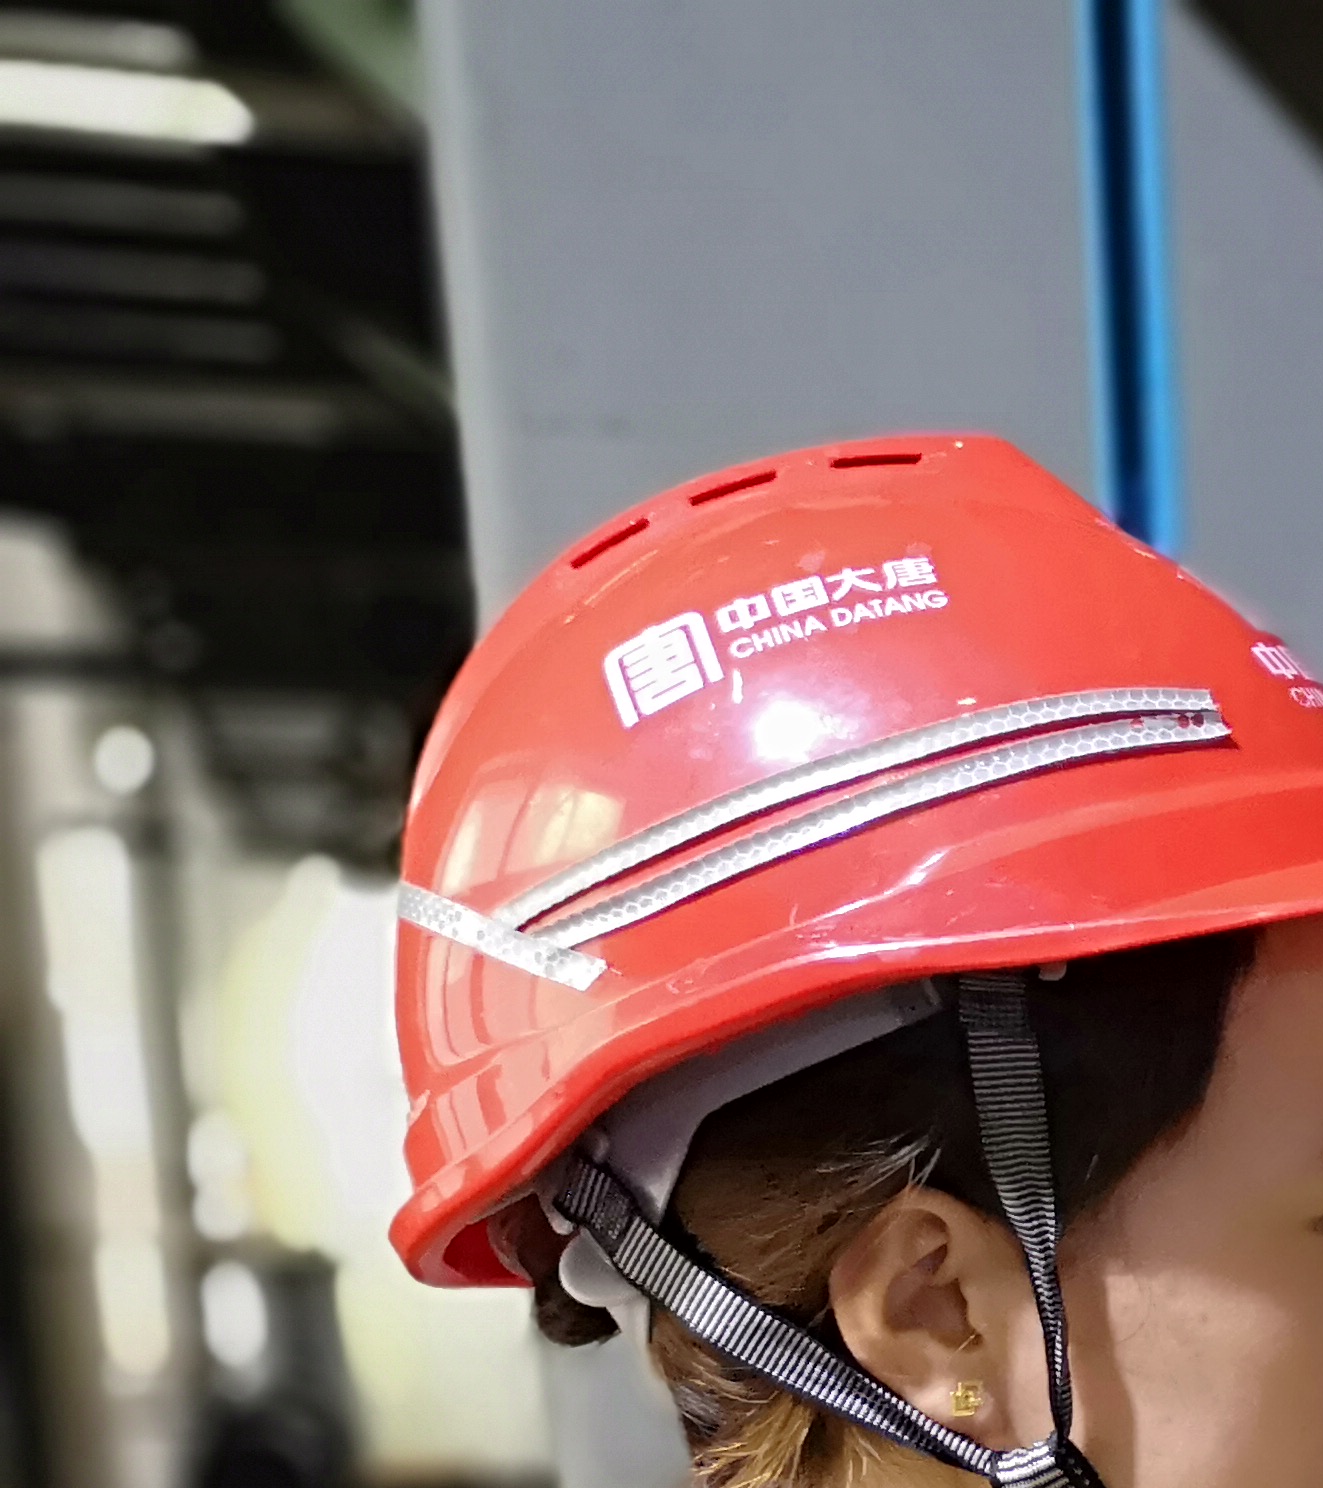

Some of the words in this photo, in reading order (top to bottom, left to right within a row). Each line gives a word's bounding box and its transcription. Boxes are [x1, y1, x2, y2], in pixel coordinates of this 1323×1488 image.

[715, 556, 938, 634] 中国大唐
[729, 615, 828, 659] CHINA
[831, 590, 949, 628] DATANG
